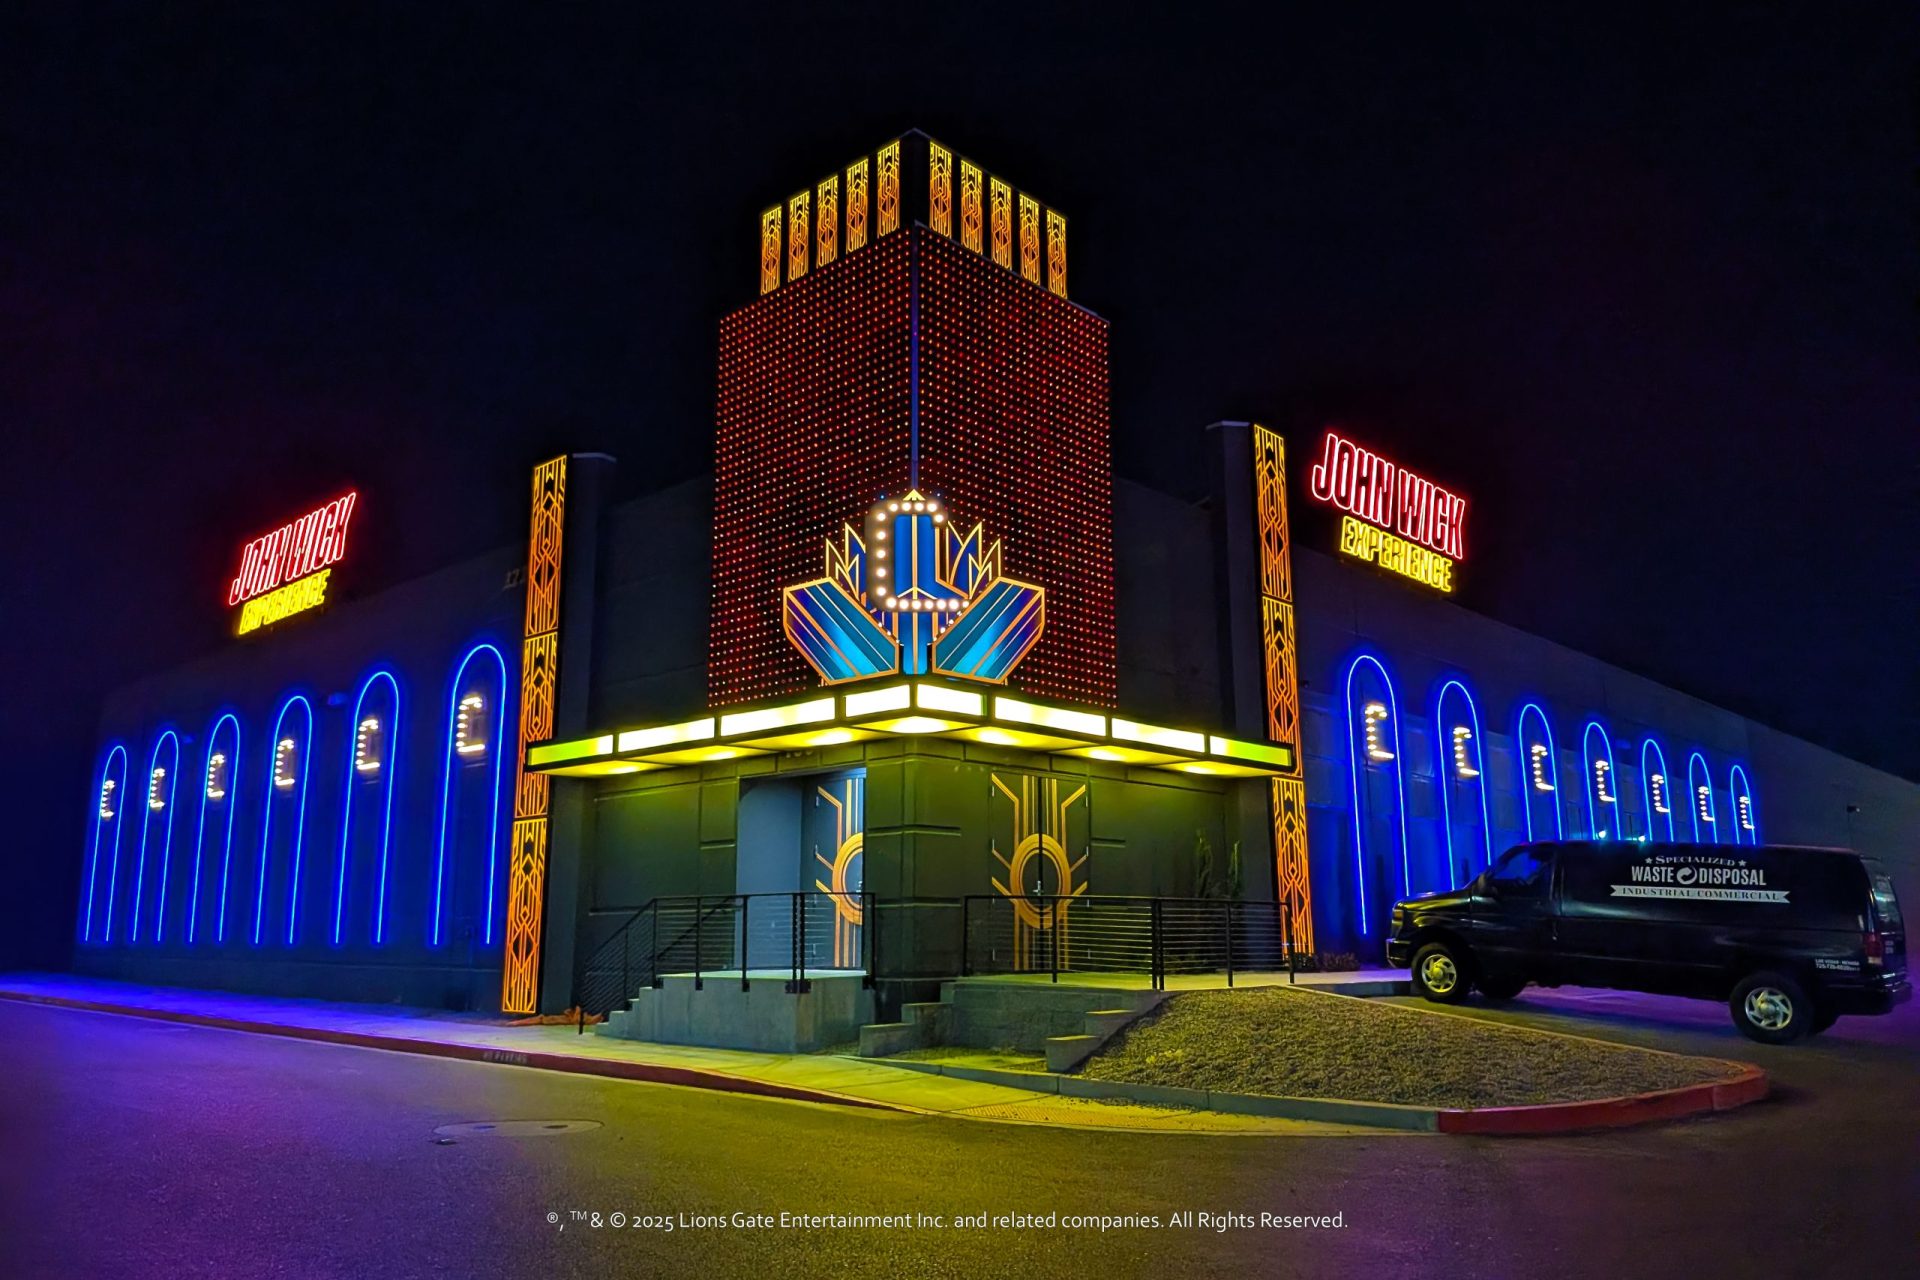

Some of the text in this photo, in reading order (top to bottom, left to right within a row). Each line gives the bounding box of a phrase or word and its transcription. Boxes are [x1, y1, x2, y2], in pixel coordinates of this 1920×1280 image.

[1312, 433, 1466, 560] JOHN WICK
[229, 492, 357, 606] JOHN WICK
[1340, 515, 1453, 593] EXPERIENCE
[1622, 887, 1780, 901] INDUSTRIAL COMMERCIAL
[1631, 866, 1767, 886] WASTE DISPOSAL
